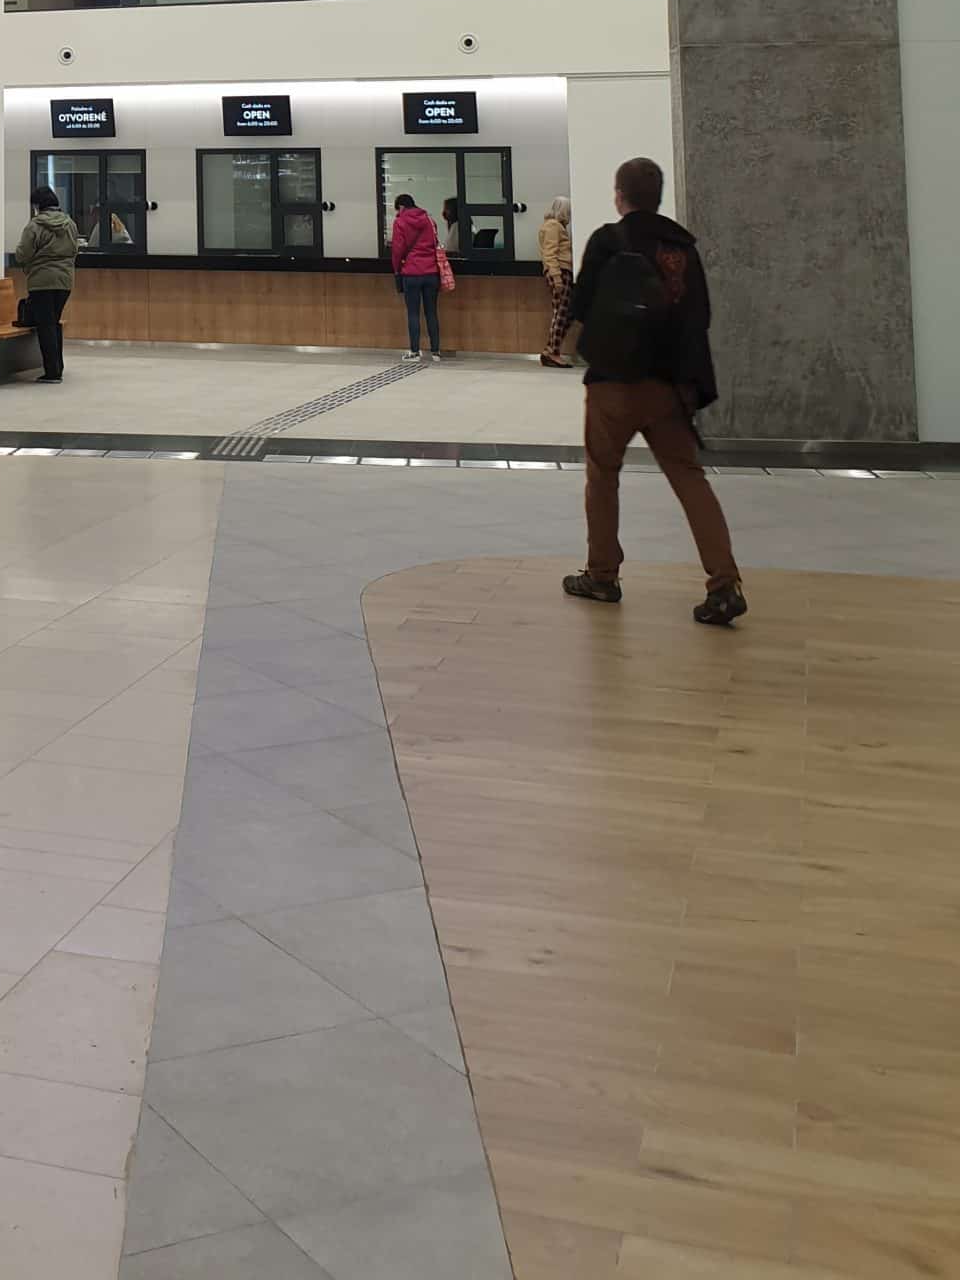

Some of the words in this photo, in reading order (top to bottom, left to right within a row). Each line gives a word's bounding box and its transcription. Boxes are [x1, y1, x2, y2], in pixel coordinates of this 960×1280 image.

[58, 111, 107, 122] OTVORENÉ
[243, 110, 271, 120] OPEN
[425, 107, 455, 117] OPEN
